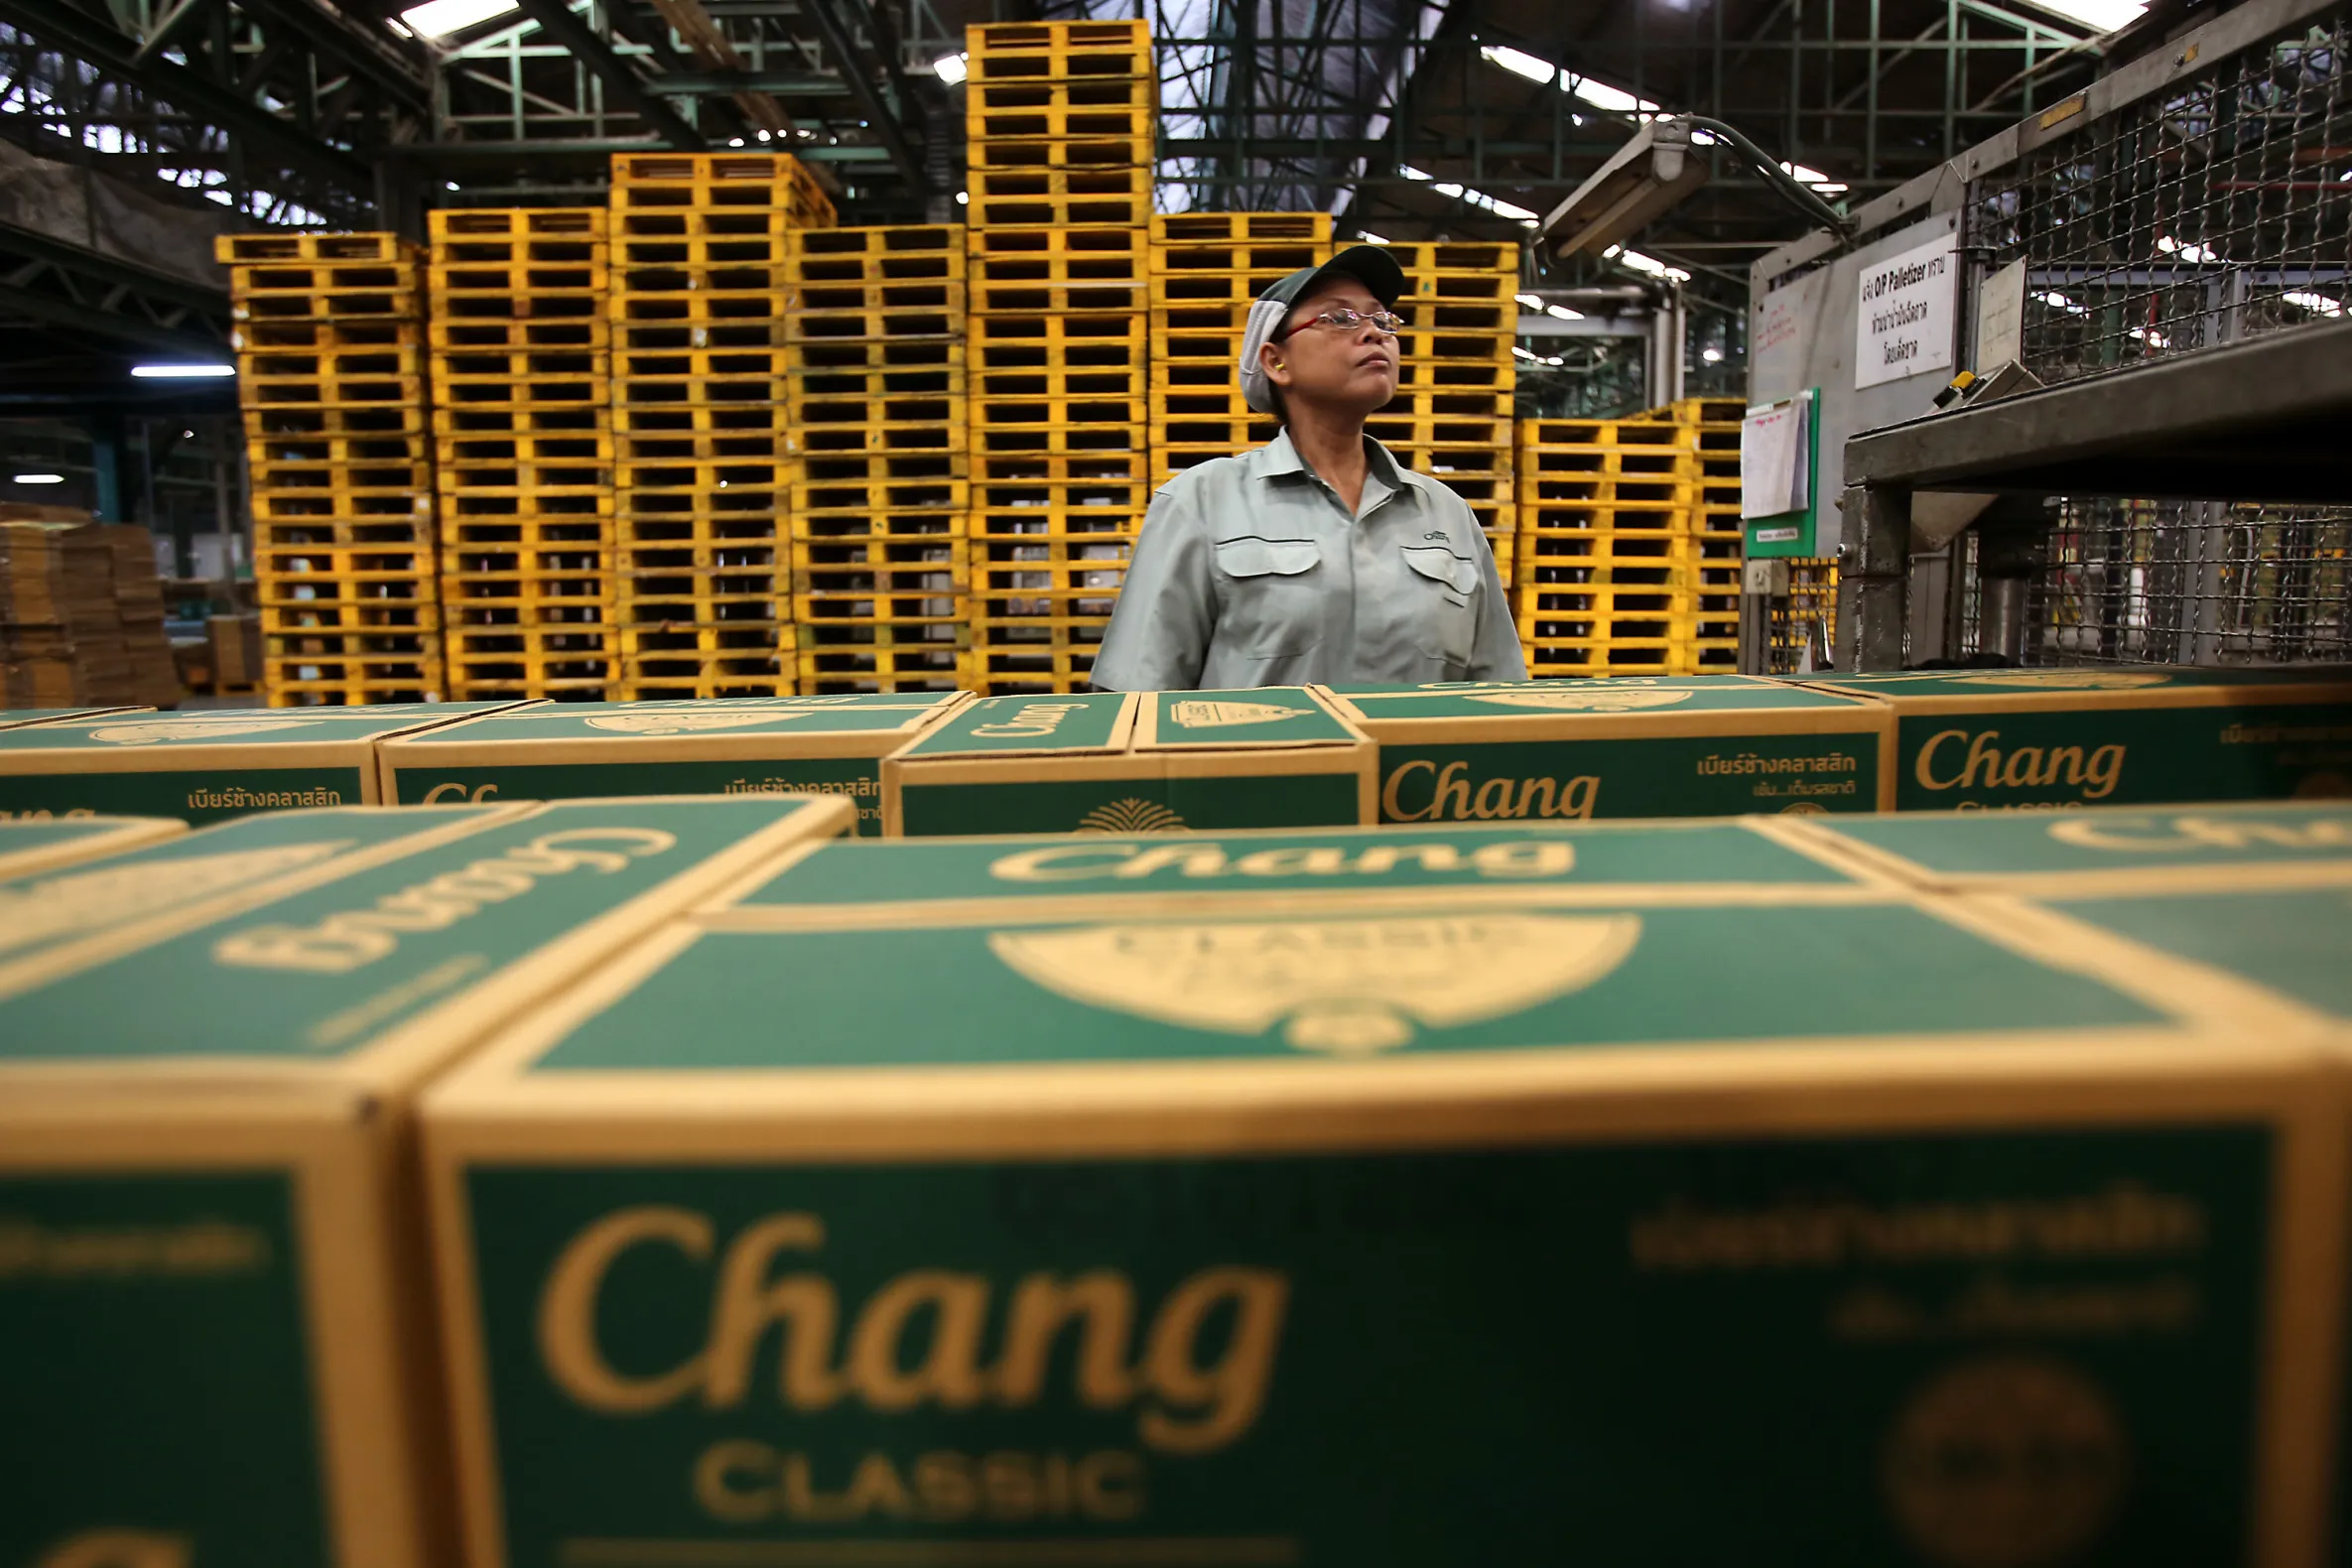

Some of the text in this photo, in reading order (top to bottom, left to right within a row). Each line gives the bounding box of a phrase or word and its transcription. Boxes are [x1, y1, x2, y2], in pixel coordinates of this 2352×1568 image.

[1875, 274, 1888, 297] OP
[1889, 263, 1926, 292] Palletizer
[1382, 760, 1600, 820] Chang
[1697, 752, 1857, 775] เบียร์ช้างคลาสสิก
[1915, 729, 2127, 798] Chang
[188, 787, 341, 808] เบียร์ช้างคลาสสิก
[988, 841, 1577, 881] Chang
[212, 828, 678, 973] Chang
[536, 1205, 1289, 1453] Chang
[694, 1439, 1146, 1519] CLASSIC
